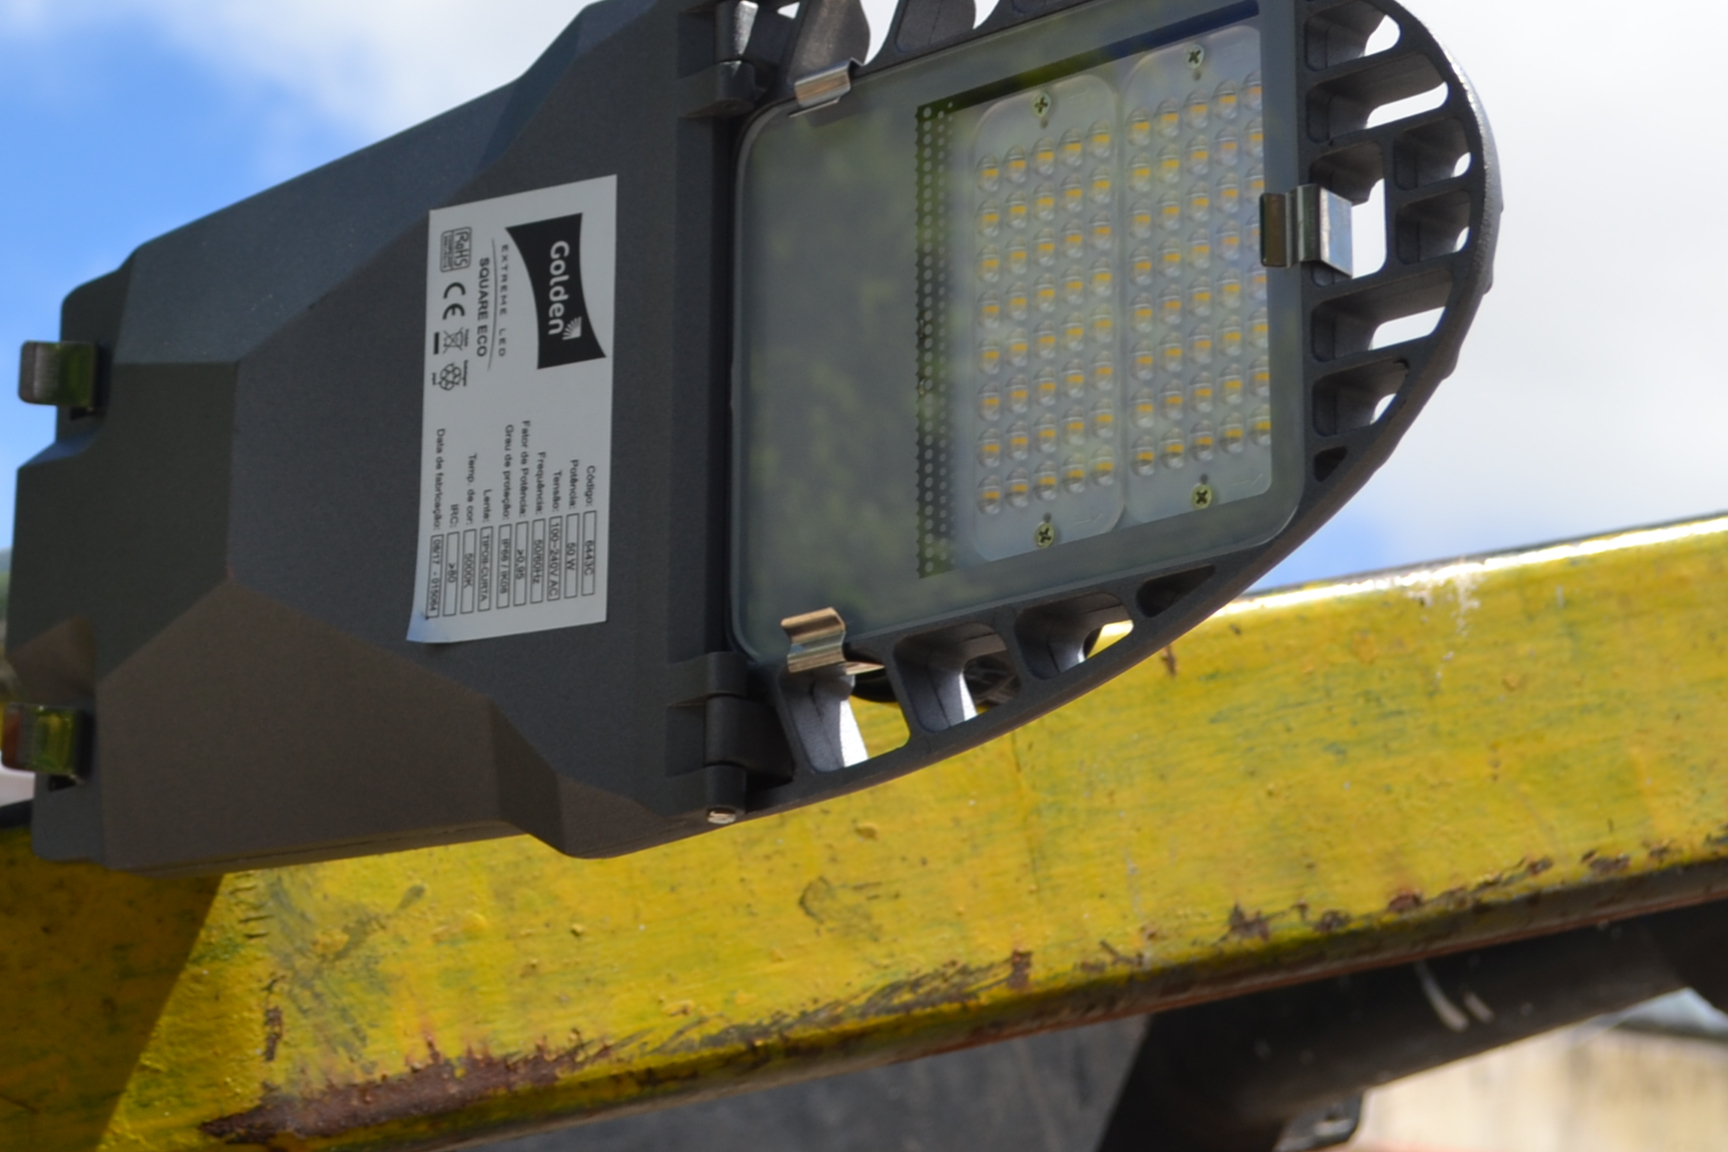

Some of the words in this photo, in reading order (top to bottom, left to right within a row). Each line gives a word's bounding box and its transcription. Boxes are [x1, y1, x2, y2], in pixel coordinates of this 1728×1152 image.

[453, 231, 470, 267] RoHS
[477, 258, 490, 321] SQUARE
[499, 244, 509, 317] EXTREME
[548, 241, 570, 335] Golden
[477, 325, 488, 357] ECO
[498, 328, 506, 357] LED
[436, 429, 445, 454] Data
[503, 425, 513, 451] Grau
[521, 420, 530, 449] Fator
[435, 457, 444, 470] de
[466, 453, 477, 485] Temp.
[503, 454, 511, 467] de
[521, 451, 528, 465] de
[468, 489, 476, 503] de
[501, 471, 511, 520] proteção:
[518, 467, 528, 517] Potência:
[534, 452, 546, 515] Frequência:
[551, 470, 562, 512] Tensão:
[569, 460, 579, 509] Potência:
[584, 466, 596, 507] Código:
[432, 472, 444, 530] fabricação:
[449, 504, 459, 527] IRC:
[466, 505, 474, 525] cor:
[482, 489, 492, 522] Lente:
[463, 553, 473, 588] 5000K
[532, 539, 542, 584] 50/60Hz
[566, 559, 575, 570] W
[584, 540, 594, 576] 6443C
[549, 580, 558, 596] AC
